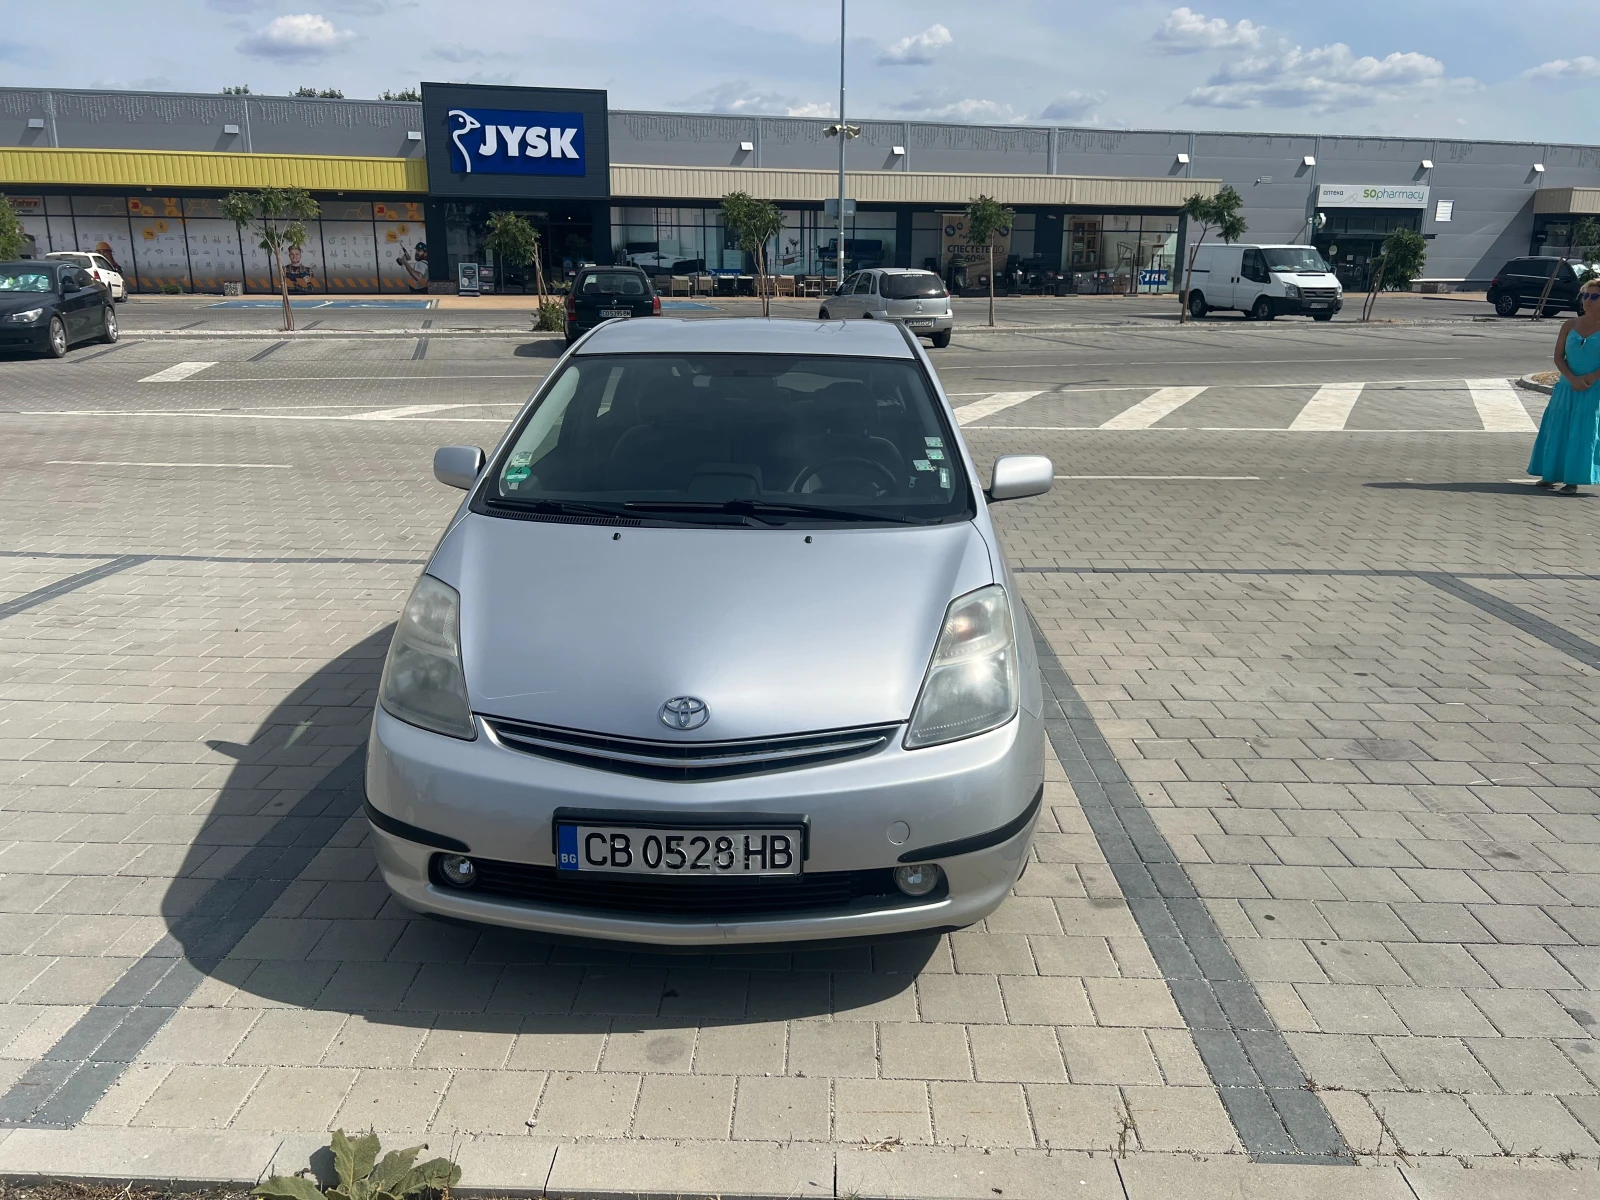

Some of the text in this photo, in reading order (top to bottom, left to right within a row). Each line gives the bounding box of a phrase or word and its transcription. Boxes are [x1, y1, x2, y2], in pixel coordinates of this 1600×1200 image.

[478, 125, 580, 159] JYSK
[561, 853, 577, 864] BG
[584, 832, 794, 870] CB 0528 HB
